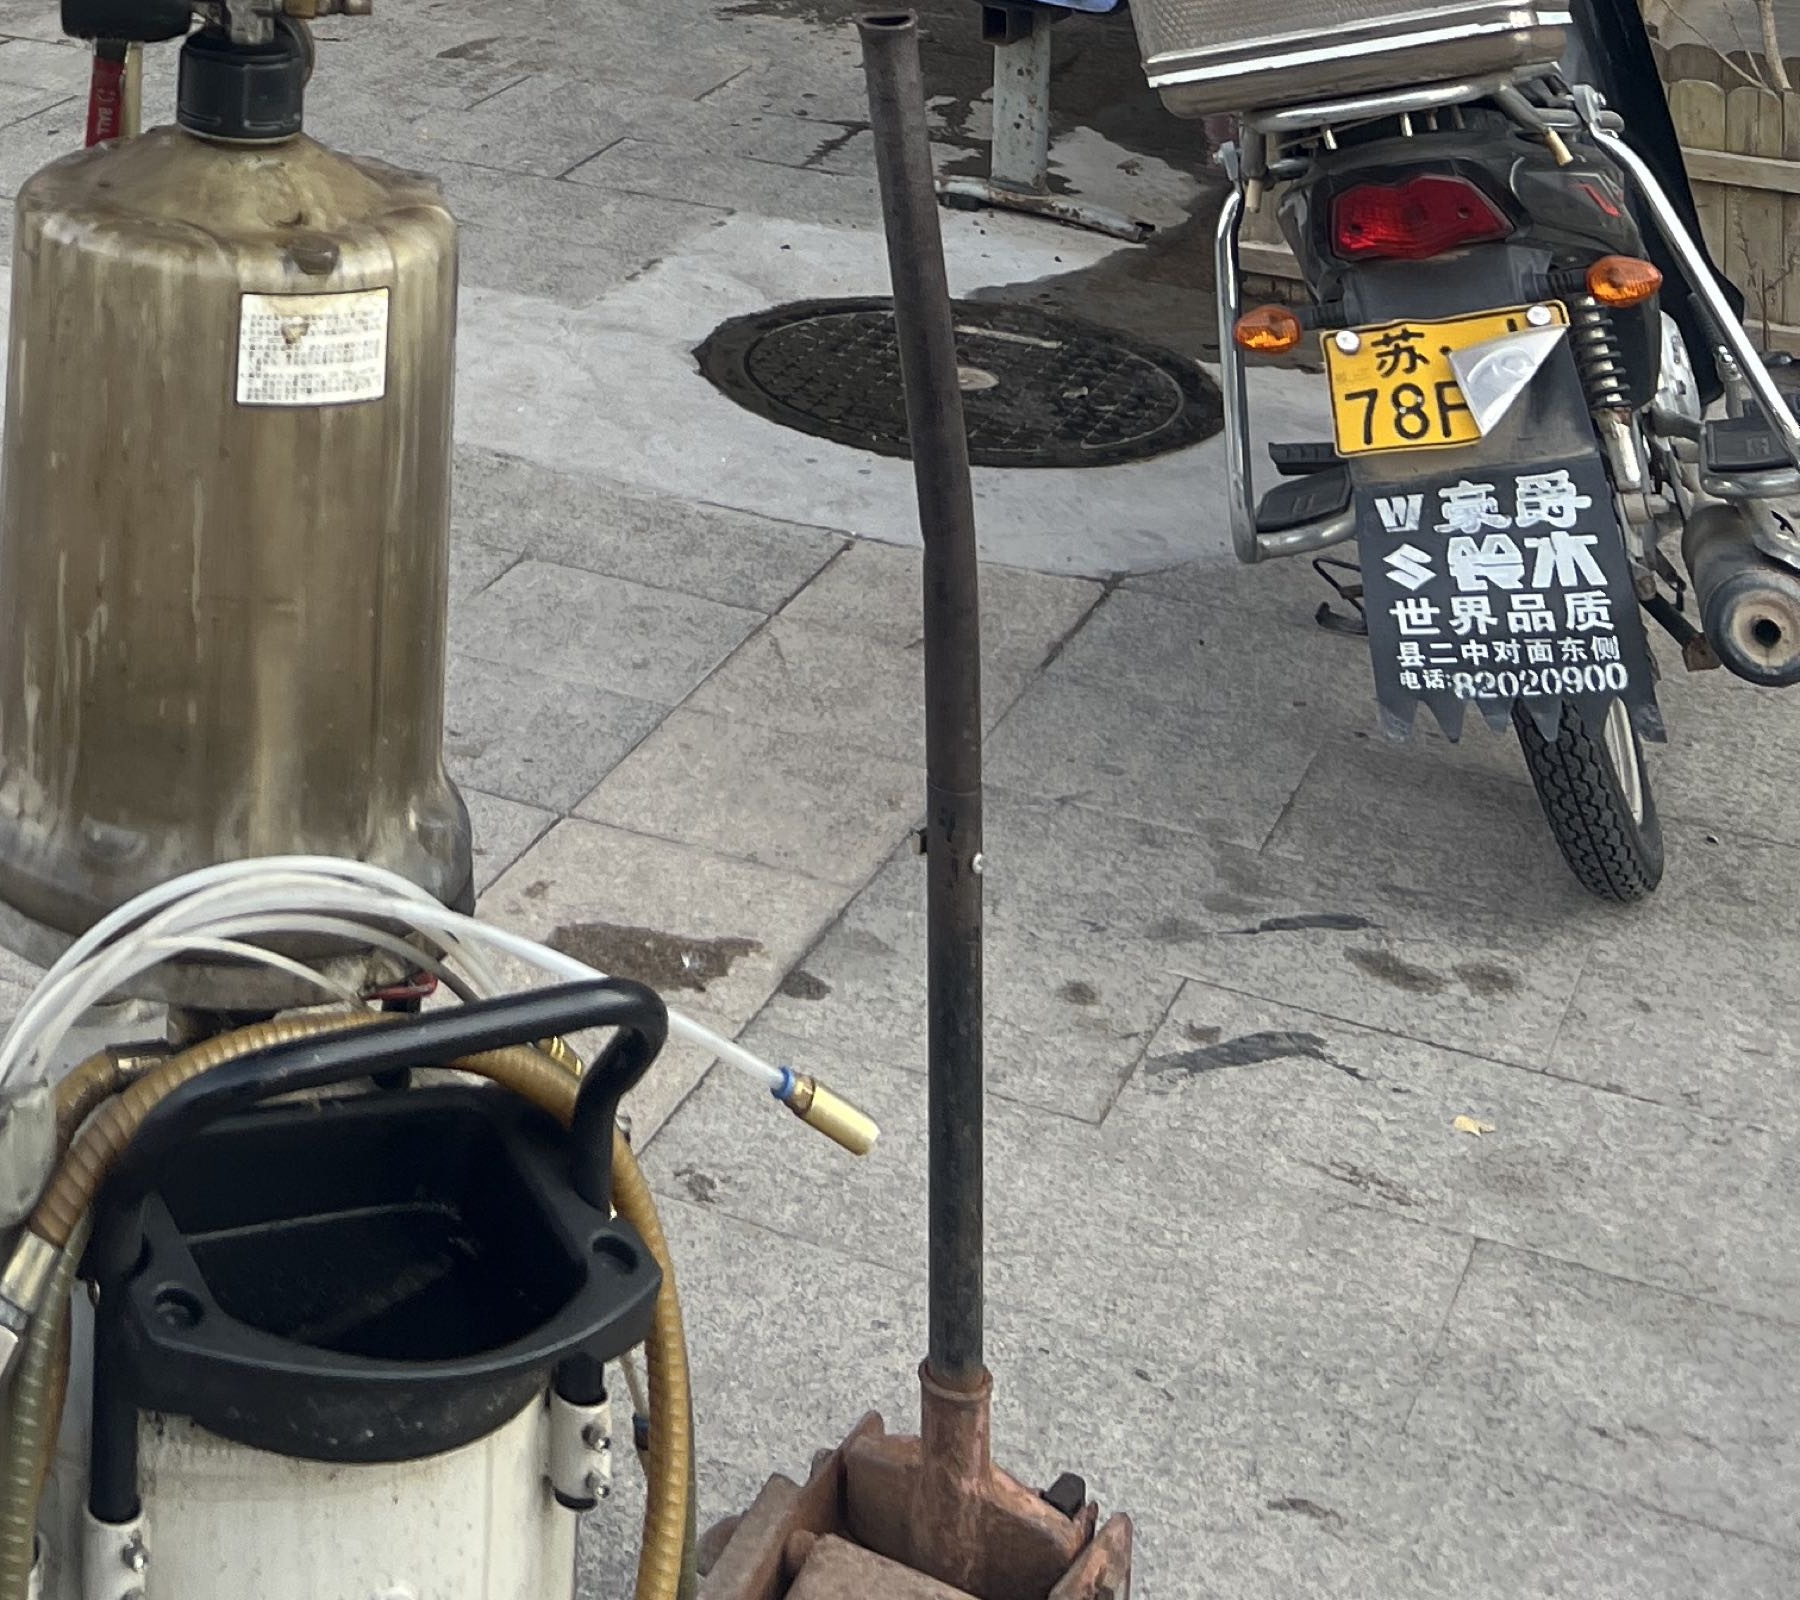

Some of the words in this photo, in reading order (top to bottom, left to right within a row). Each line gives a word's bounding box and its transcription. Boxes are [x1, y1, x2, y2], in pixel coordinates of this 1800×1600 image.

[1433, 469, 1593, 534] 豪爵
[1447, 531, 1609, 592] 铃木
[1389, 590, 1615, 637] 世界品质
[1396, 635, 1622, 669] 县二中对面东侧
